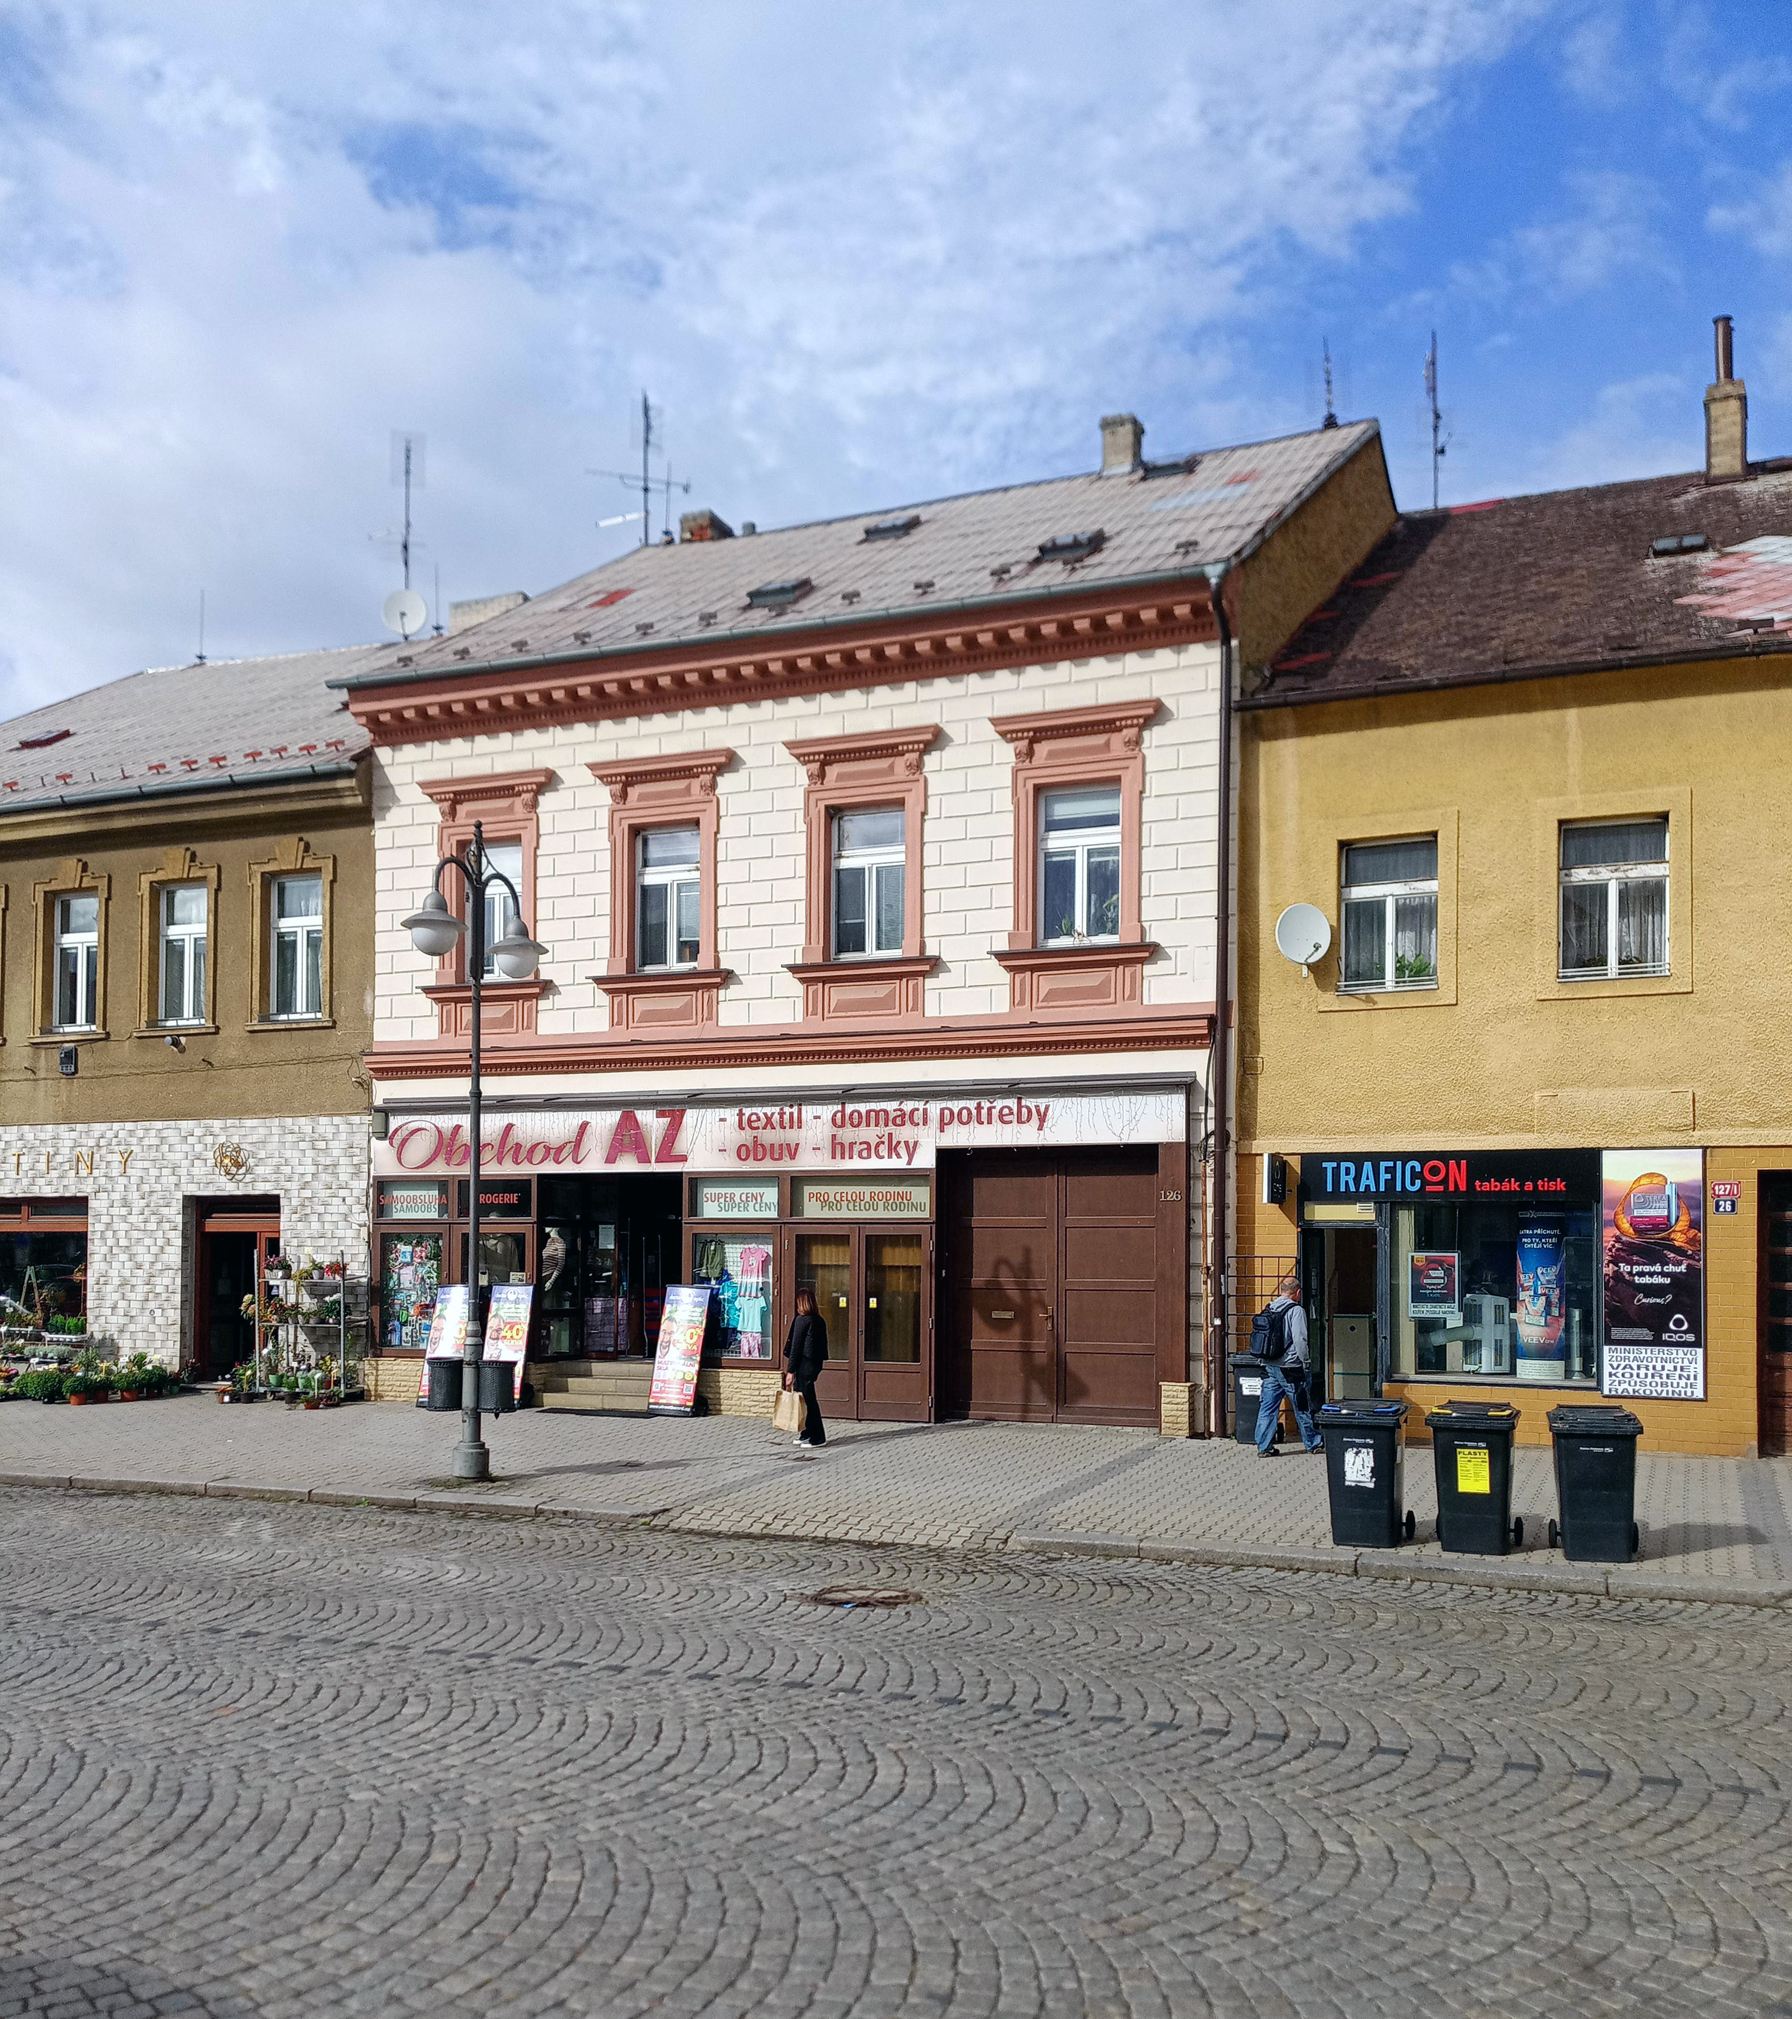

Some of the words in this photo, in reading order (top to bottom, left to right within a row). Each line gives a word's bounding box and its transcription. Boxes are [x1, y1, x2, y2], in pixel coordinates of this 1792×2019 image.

[736, 1103, 803, 1131] textil
[831, 1099, 930, 1128] domácí
[939, 1096, 1051, 1133] potřeby
[388, 1118, 592, 1169] Obchod
[603, 1108, 688, 1165] AZ
[736, 1135, 800, 1162] obuv
[830, 1132, 920, 1166] hračky
[12, 1149, 134, 1176] TINY
[1322, 1160, 1467, 1193] TRAFICON
[1474, 1177, 1520, 1192] tabák
[1523, 1181, 1533, 1192] a
[1536, 1177, 1567, 1192] tisk
[479, 1193, 519, 1204] ROGERIE
[703, 1192, 736, 1203] SUPER
[739, 1192, 766, 1203] CENY
[808, 1191, 830, 1203] PRO
[833, 1191, 866, 1202] CELOU
[869, 1190, 913, 1202] RODINU
[1160, 1190, 1182, 1201] 126
[1718, 1200, 1732, 1212] 26
[1618, 1263, 1631, 1272] Ta
[1632, 1263, 1661, 1274] pravá
[1663, 1263, 1687, 1273] chuť
[1634, 1274, 1671, 1284] tabáku
[1633, 1292, 1673, 1305] Curious?
[1662, 1332, 1696, 1342] IQOS
[1608, 1347, 1698, 1357] MINISTERSTVO
[1608, 1355, 1699, 1365] ZDRAVOTNICTVÍ
[1608, 1363, 1698, 1373] VARUJE:
[1608, 1371, 1699, 1381] KOUŘENÍ
[1608, 1379, 1698, 1389] ZPŮSOBUJE
[1608, 1387, 1699, 1398] RAKOVINU.
